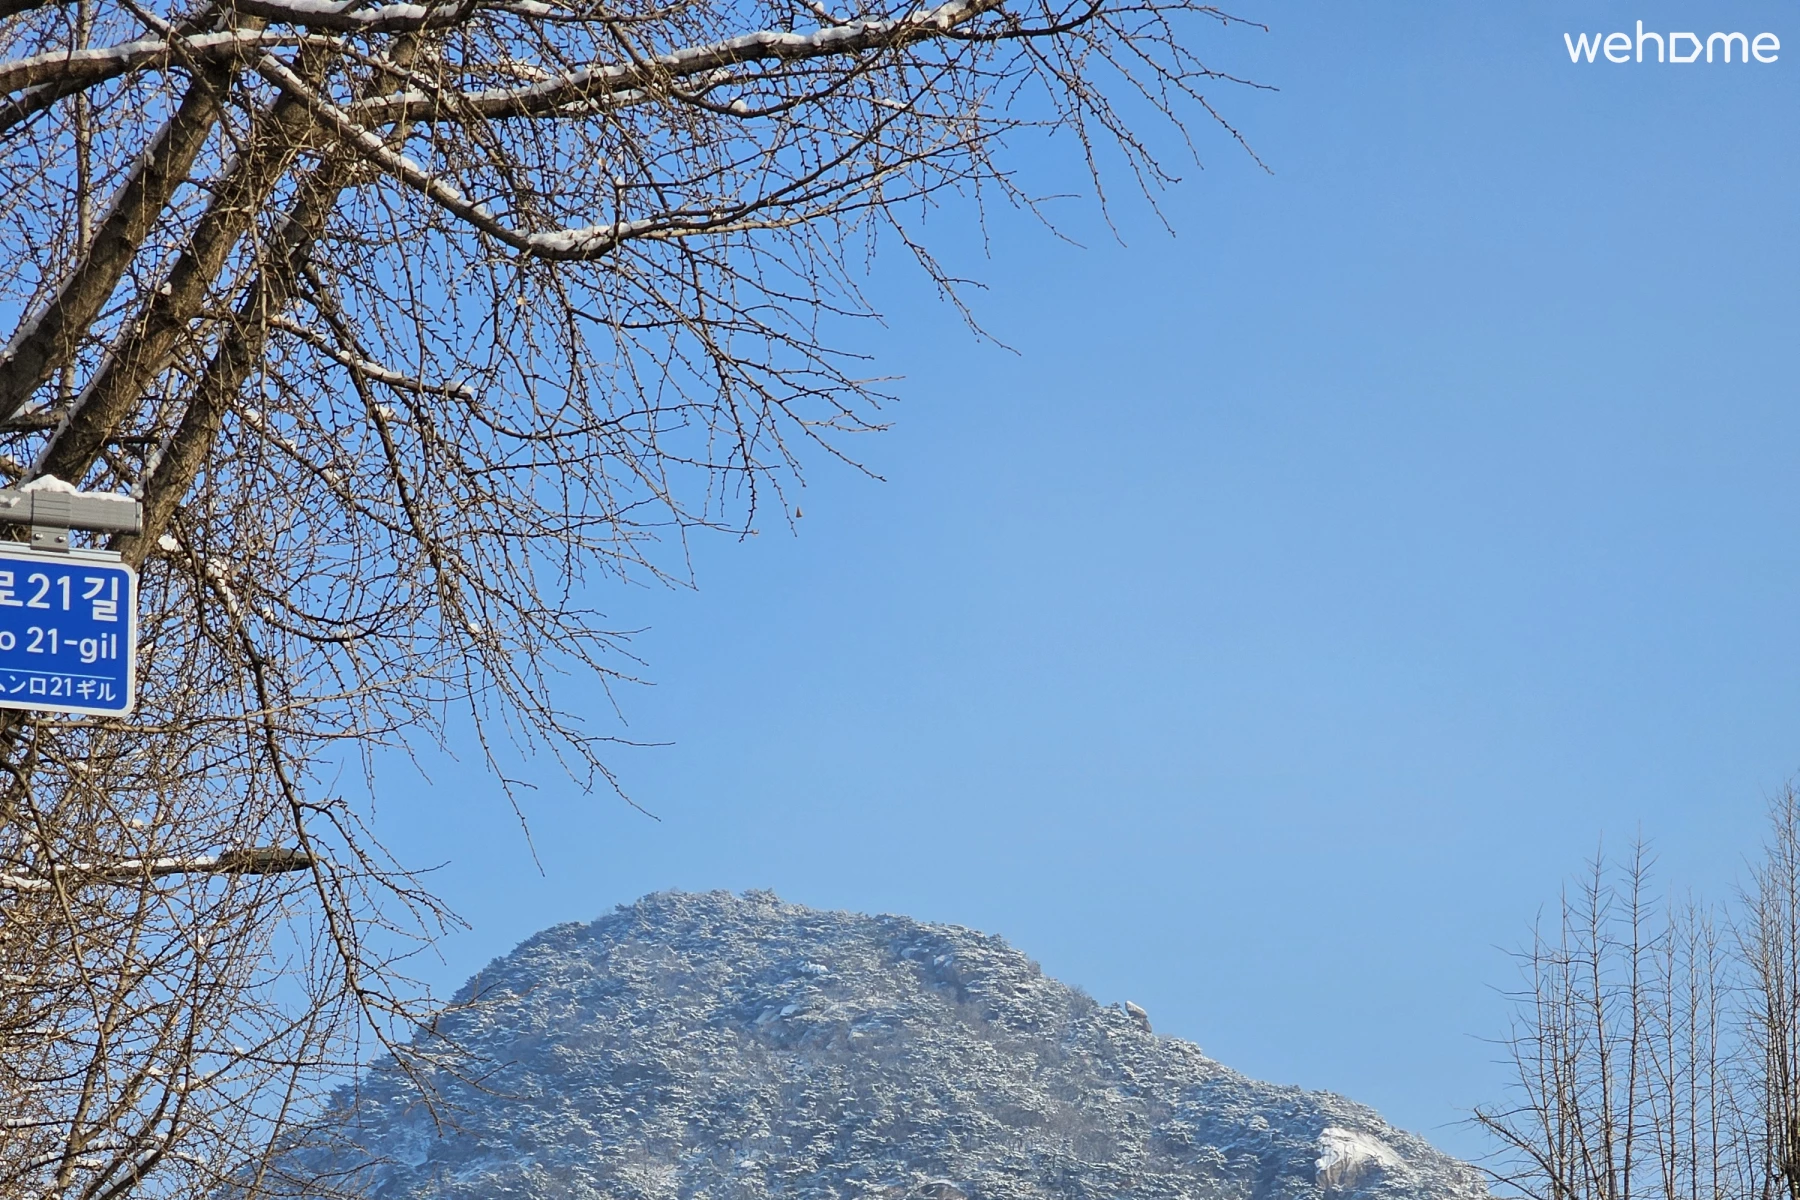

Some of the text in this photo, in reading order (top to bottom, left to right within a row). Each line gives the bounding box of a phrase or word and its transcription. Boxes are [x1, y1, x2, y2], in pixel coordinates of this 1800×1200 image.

[26, 626, 117, 665] 21-gil
[0, 675, 116, 702] ンロ21ギル
